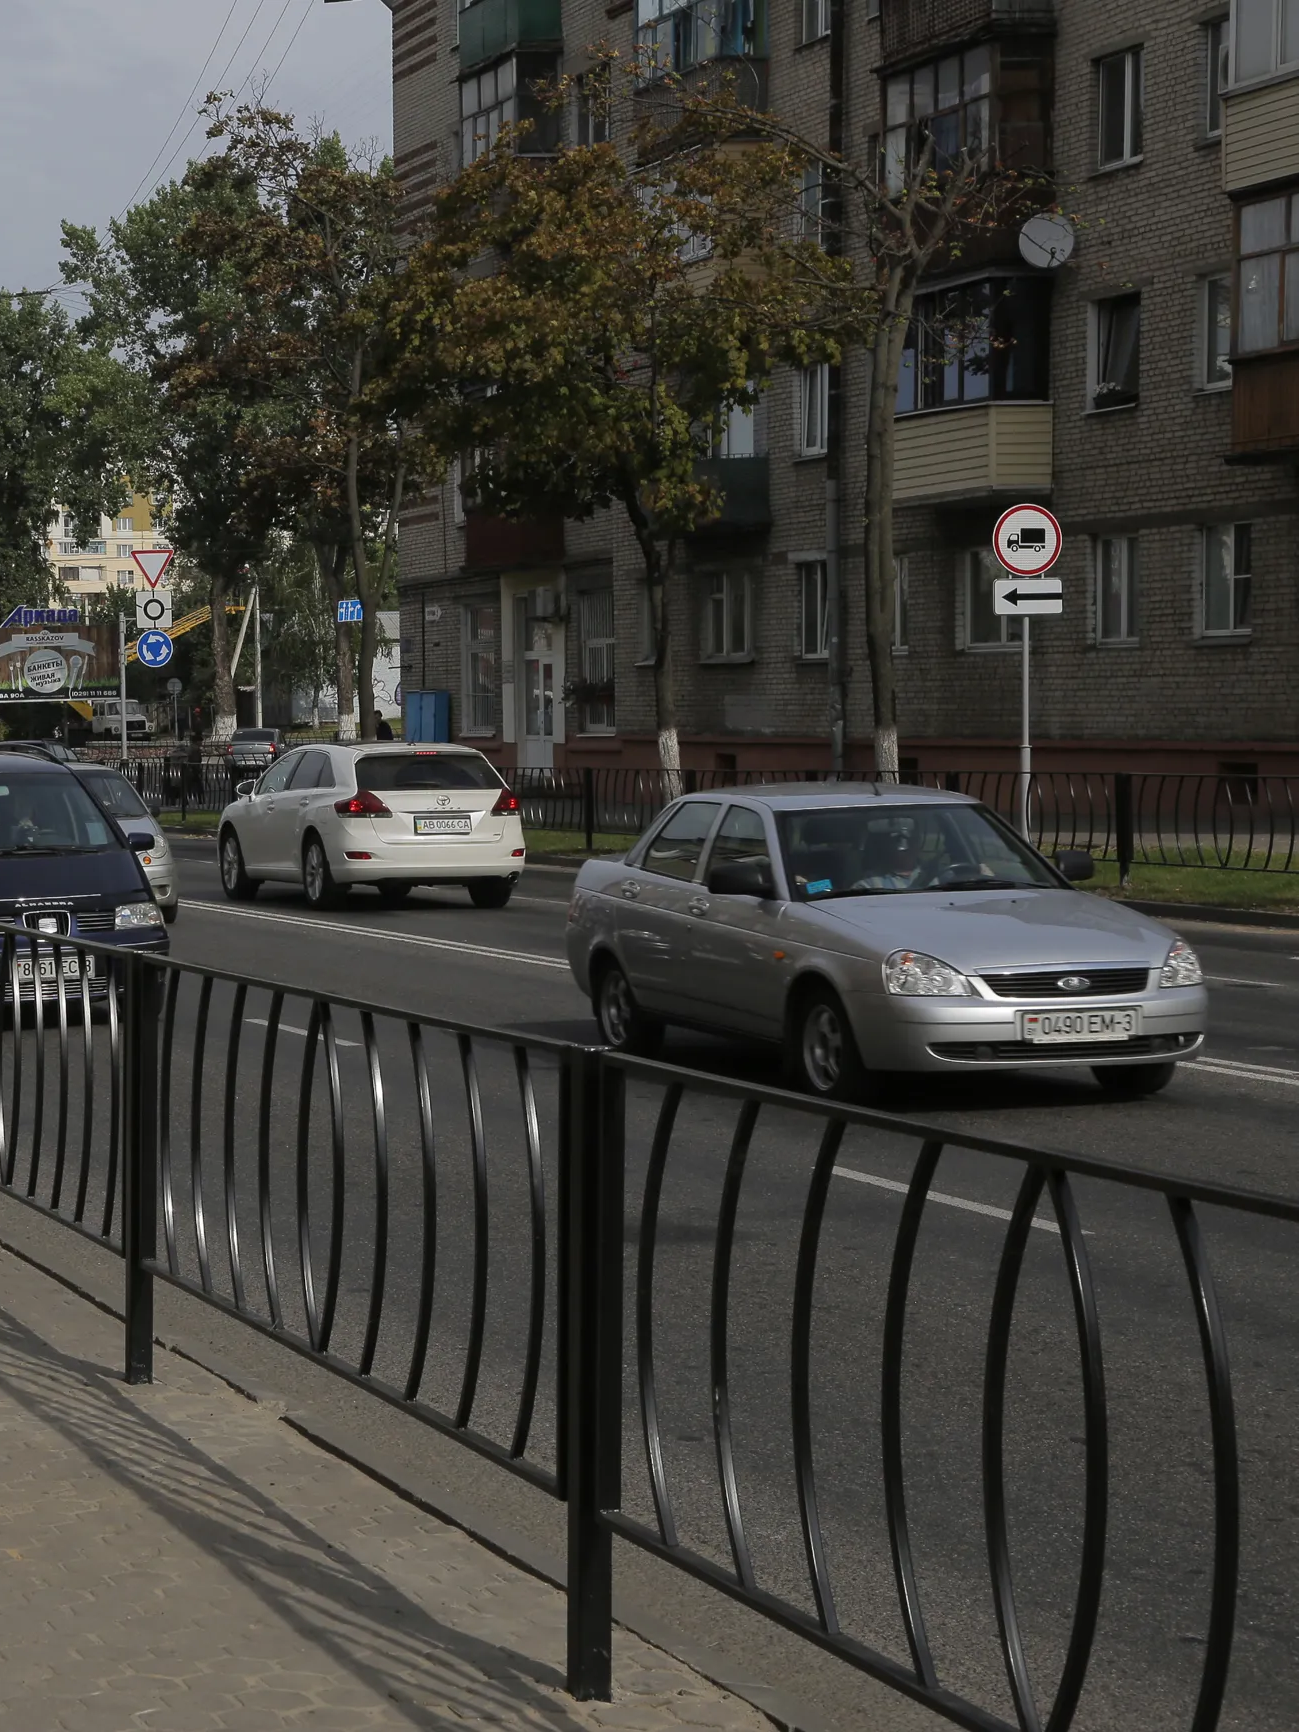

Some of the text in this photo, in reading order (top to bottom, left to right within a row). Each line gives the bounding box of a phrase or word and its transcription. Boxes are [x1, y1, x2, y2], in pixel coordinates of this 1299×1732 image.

[0, 605, 79, 628] Аркада
[27, 660, 63, 673] БАНКЕТЫ
[30, 672, 56, 682] ЖИВАЯ
[35, 677, 61, 687] музыка
[423, 820, 470, 829] AB 0066 CA
[23, 961, 54, 976] 861
[1042, 1013, 1133, 1035] 0490 EM-3
